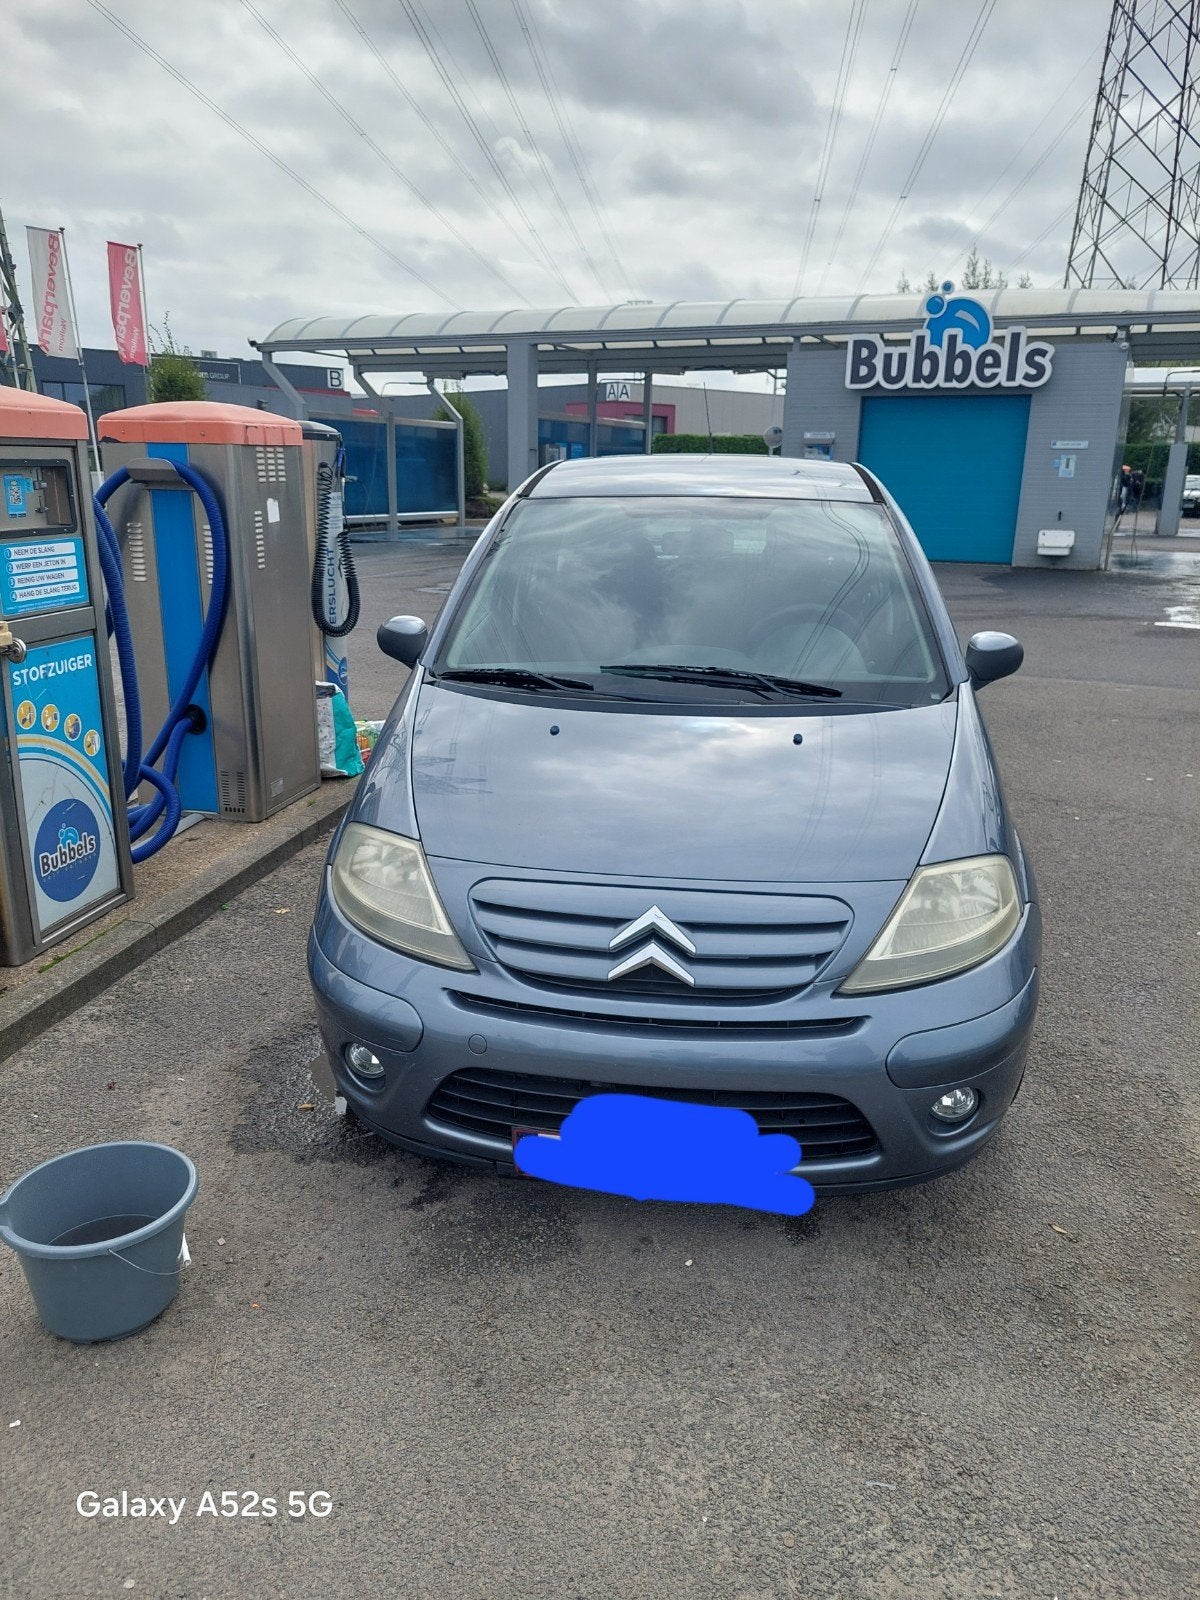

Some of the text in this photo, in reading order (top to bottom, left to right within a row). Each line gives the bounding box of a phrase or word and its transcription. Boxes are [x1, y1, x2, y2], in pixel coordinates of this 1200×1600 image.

[848, 329, 1052, 387] Bubbels
[330, 370, 342, 387] B
[15, 562, 32, 570] WERP
[44, 559, 60, 567] JETON
[17, 576, 35, 584] REINIG
[46, 572, 65, 580] WAGEN
[326, 547, 337, 626] ERSLUCHT
[19, 590, 34, 598] HANG
[44, 586, 60, 594] SLANG
[12, 653, 93, 686] STOFZUIGER
[40, 833, 96, 876] Bubbels
